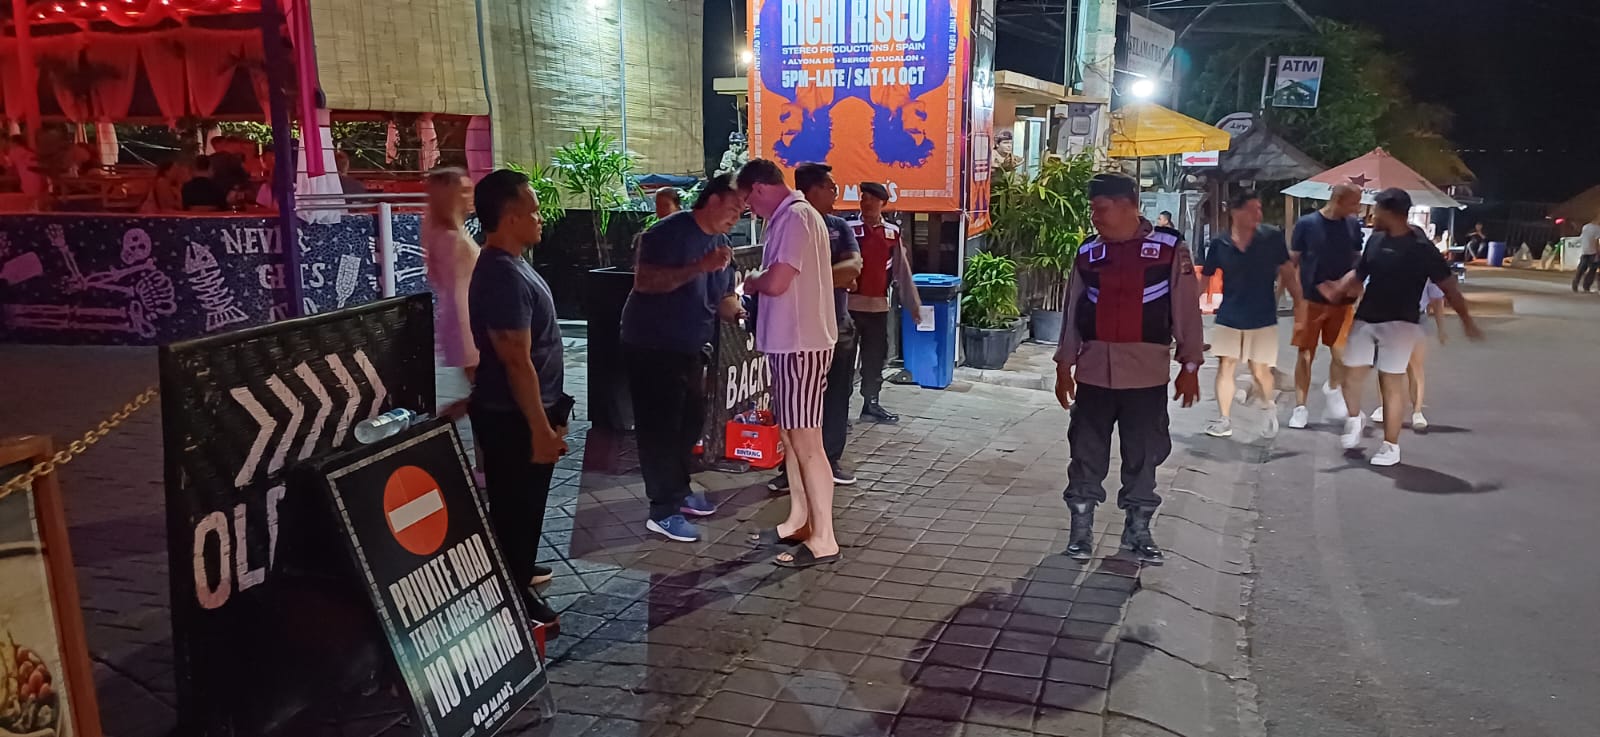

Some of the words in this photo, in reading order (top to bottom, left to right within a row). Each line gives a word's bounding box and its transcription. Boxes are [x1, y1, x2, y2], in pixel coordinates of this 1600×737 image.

[782, 0, 845, 45] RICHI
[851, 0, 927, 43] RISCO
[782, 47, 818, 55] STEREO
[820, 44, 889, 54] PRODUCTIONS
[896, 43, 925, 51] SPAIN
[842, 56, 873, 64] SERGIO
[876, 55, 919, 63] CUCALON
[1282, 60, 1318, 73] ATM
[854, 67, 880, 87] SAT
[882, 67, 897, 86] 14
[899, 66, 926, 86] OCT
[388, 554, 459, 628] PRIVATE
[447, 533, 492, 590] ROAD
[409, 612, 451, 661] TEMPLE
[445, 589, 484, 637] ACCESS
[478, 574, 504, 611] ONLY
[423, 655, 461, 718] NO
[449, 607, 523, 697] PARKING
[473, 703, 490, 727] OLD
[488, 681, 514, 713] MAN'S
